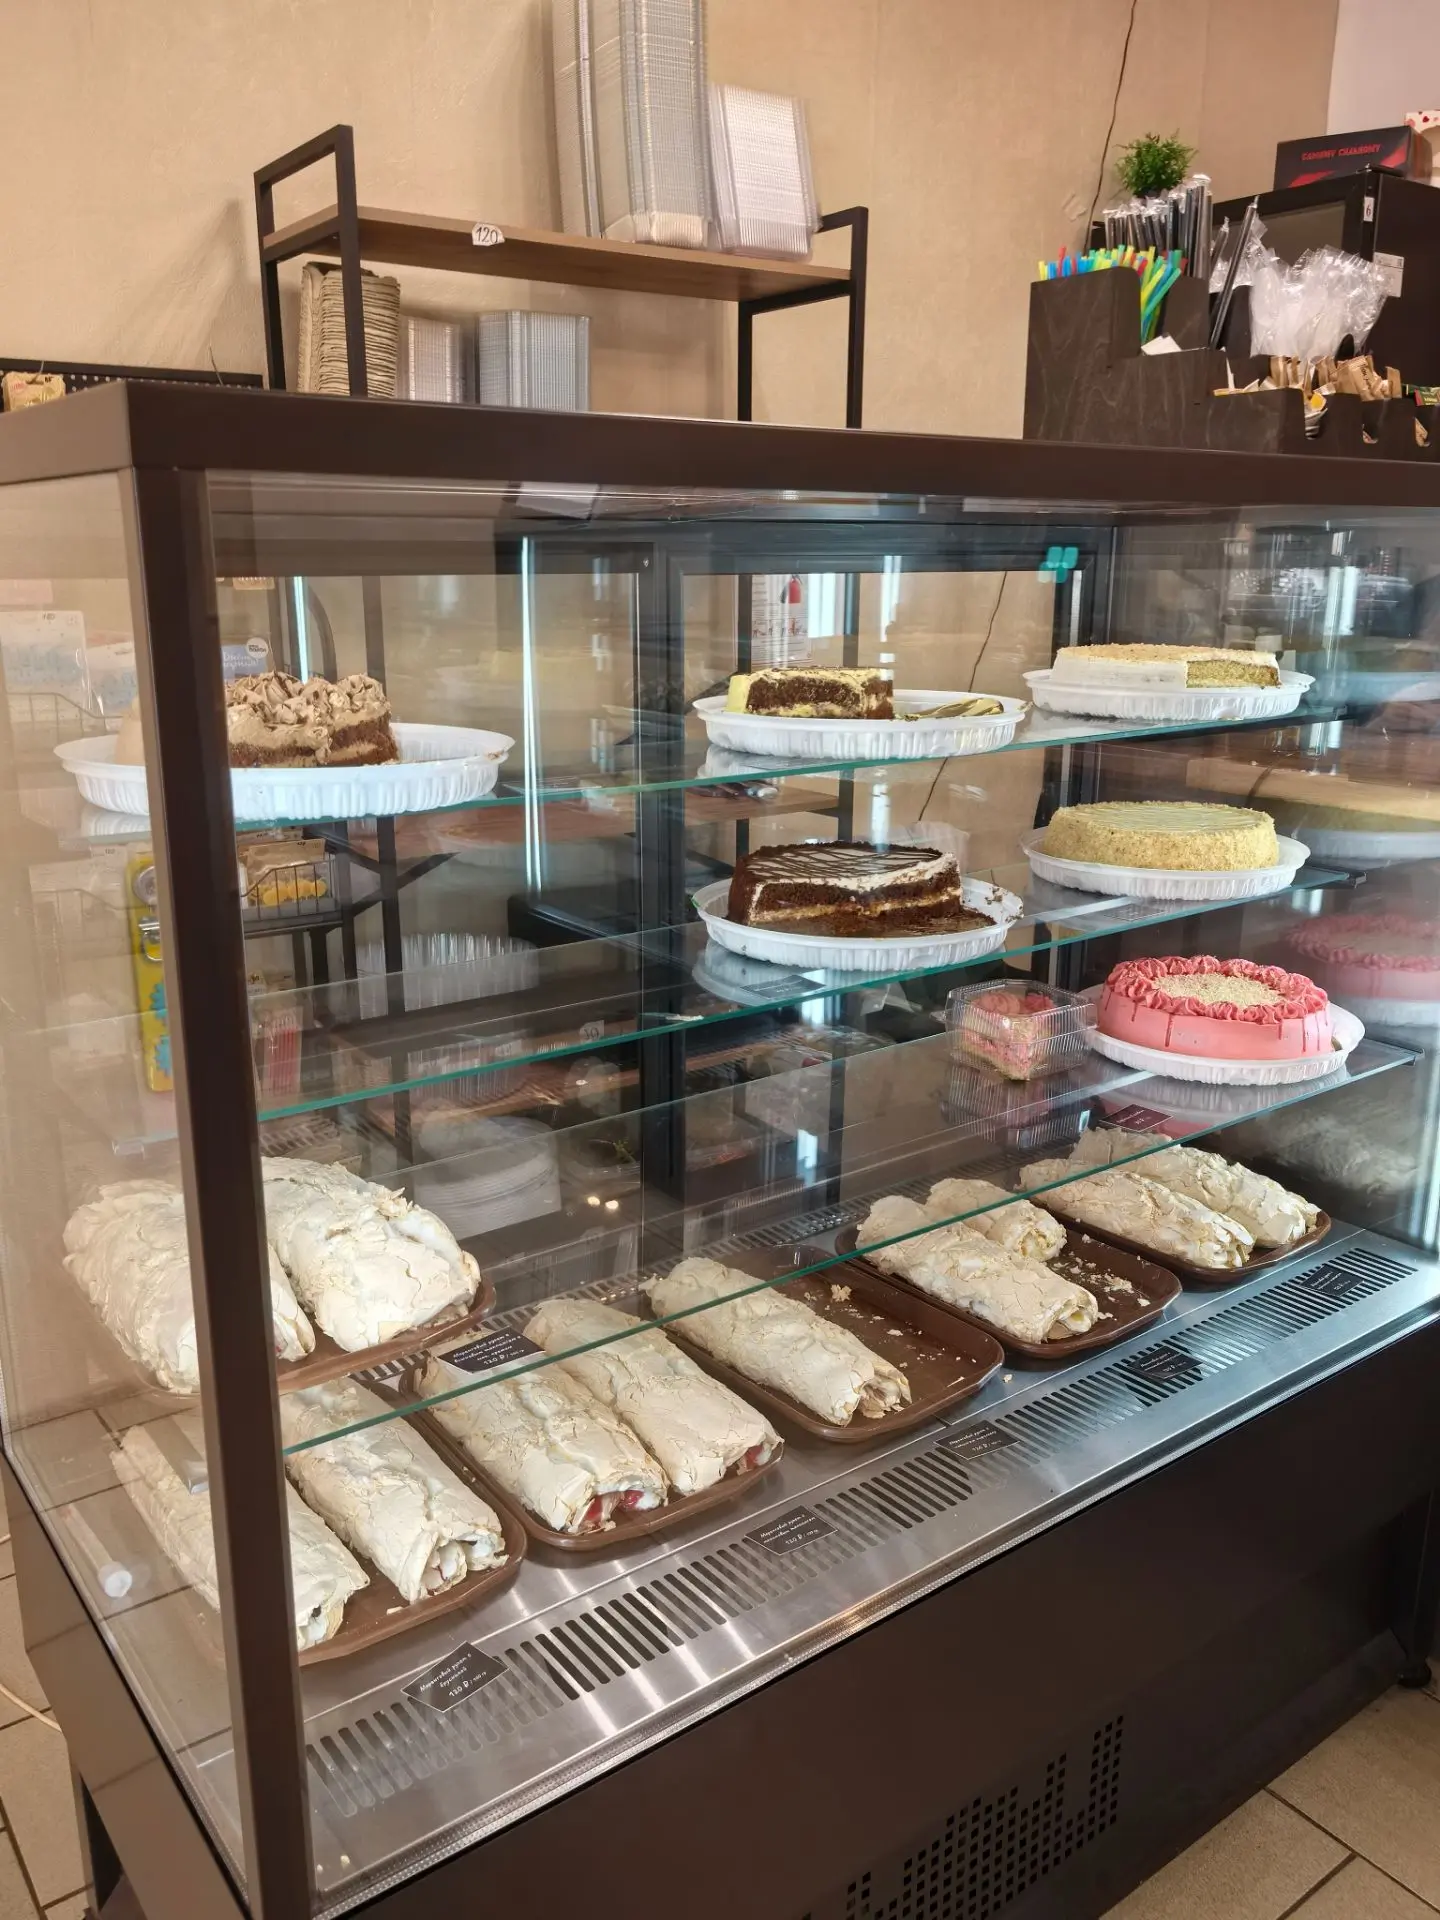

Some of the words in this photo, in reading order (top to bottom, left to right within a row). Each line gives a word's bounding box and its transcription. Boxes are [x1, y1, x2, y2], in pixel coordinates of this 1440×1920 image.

[476, 226, 498, 244] 120
[483, 1357, 498, 1365] 120
[448, 1686, 463, 1697] 120
